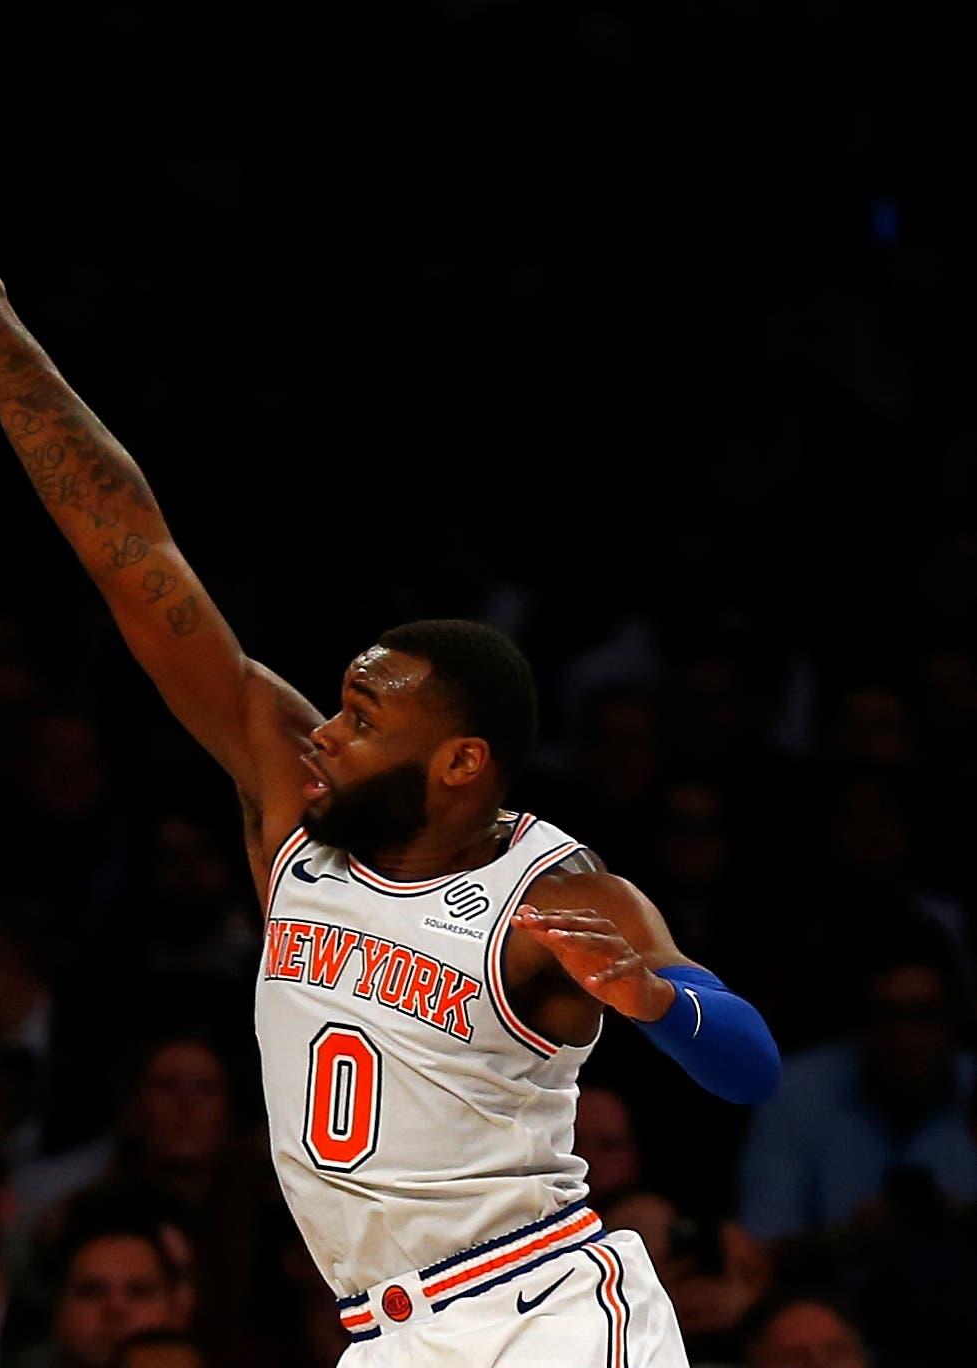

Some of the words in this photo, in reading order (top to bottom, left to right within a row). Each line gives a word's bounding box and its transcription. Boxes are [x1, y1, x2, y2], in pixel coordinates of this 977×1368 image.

[264, 917, 361, 990] NEW
[353, 930, 483, 1044] YORK
[424, 917, 485, 940] SQUARESPACE
[302, 1021, 383, 1174] 0
